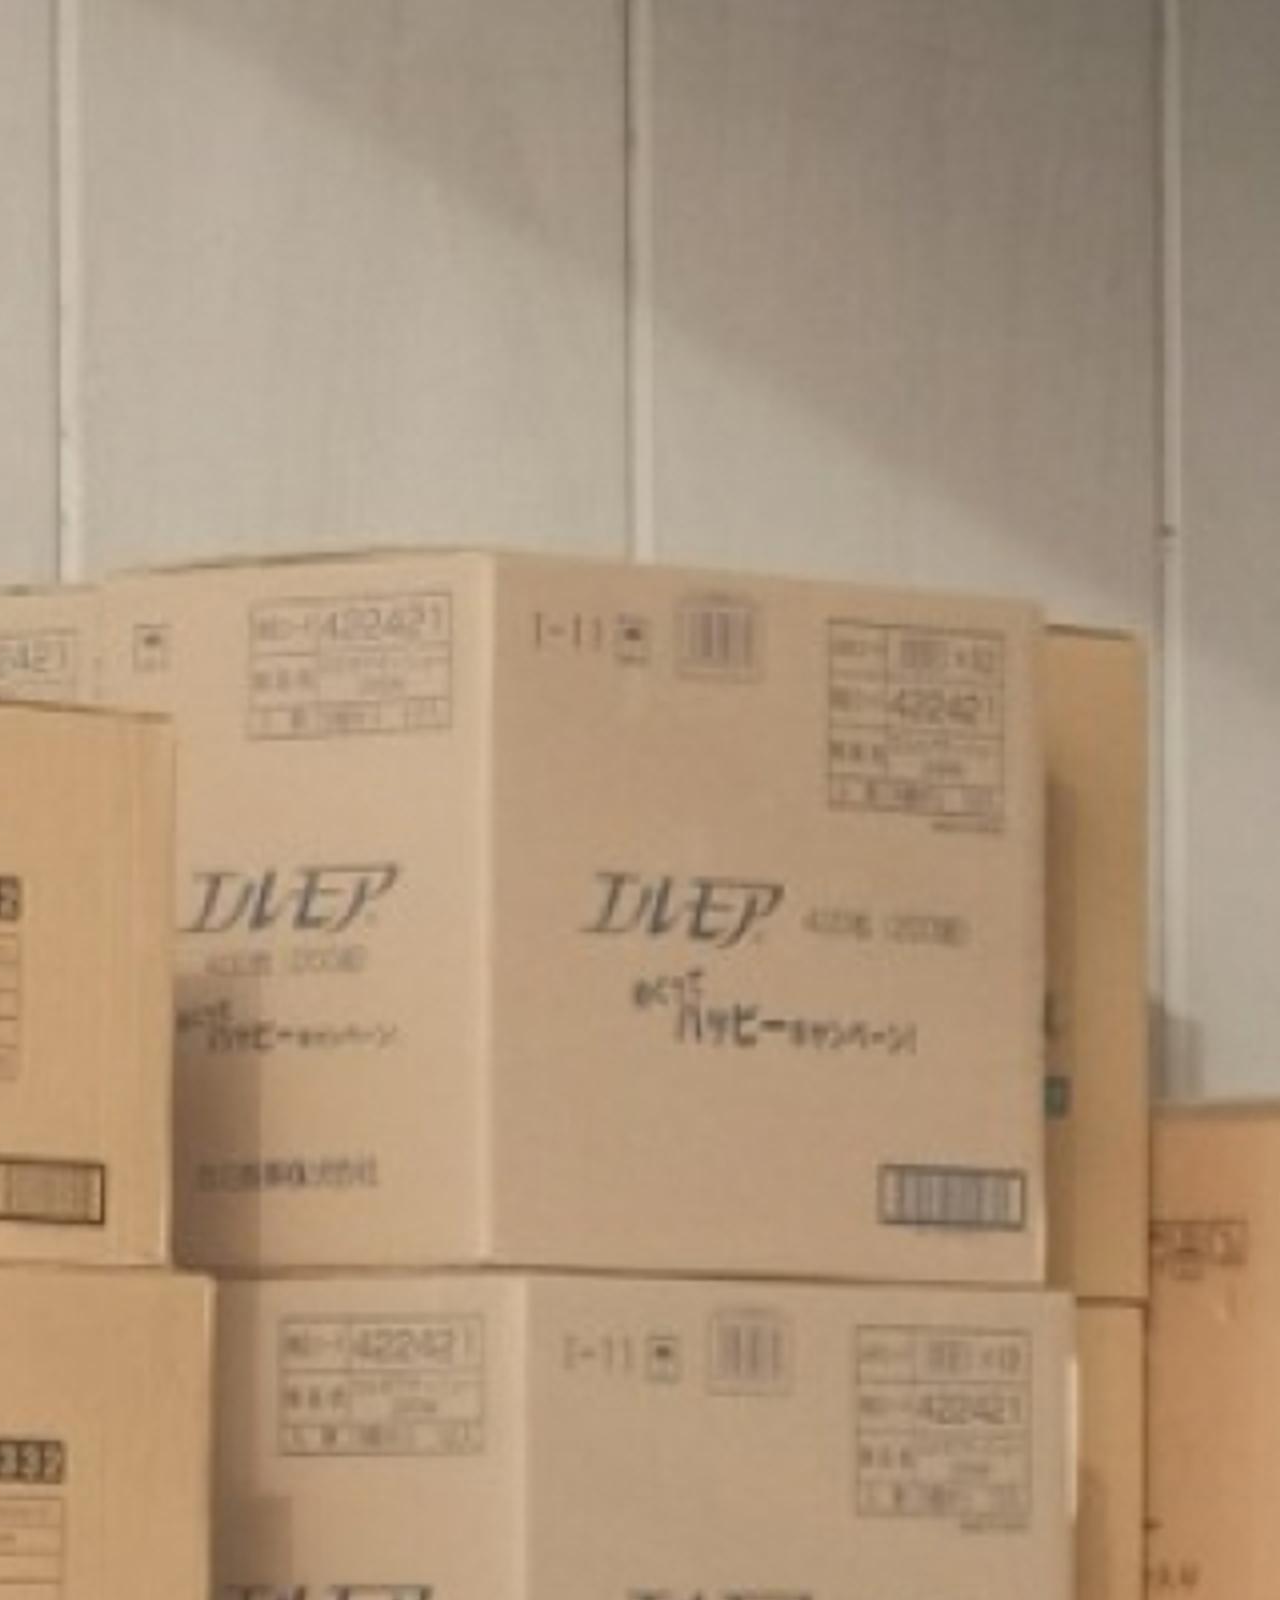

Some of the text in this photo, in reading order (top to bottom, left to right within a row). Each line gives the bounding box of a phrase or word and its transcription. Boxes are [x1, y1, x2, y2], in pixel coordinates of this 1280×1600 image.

[178, 864, 399, 934] エルモア
[582, 871, 785, 947] エルモア
[350, 1328, 472, 1365] 422421
